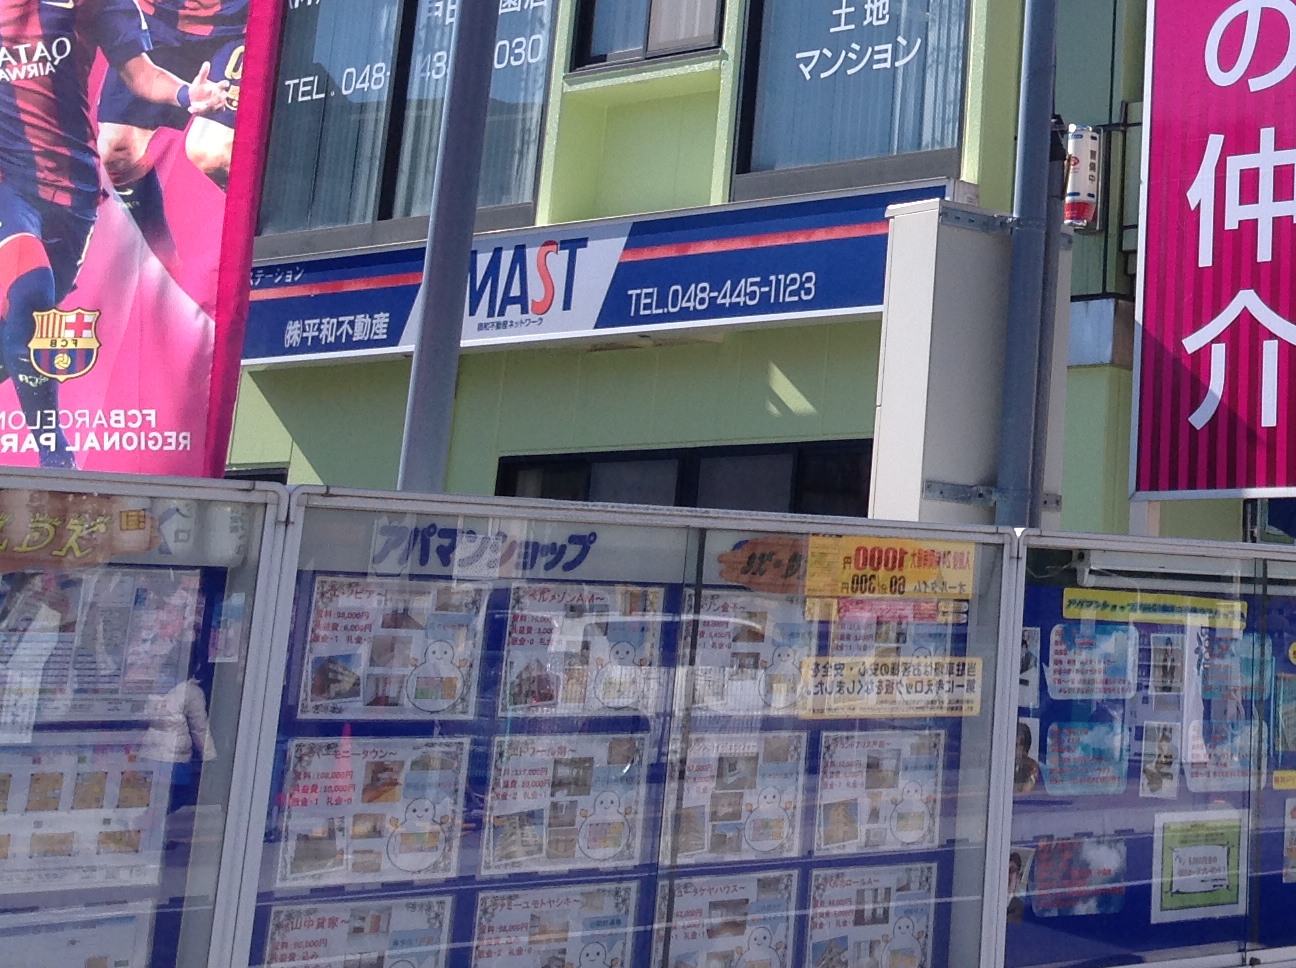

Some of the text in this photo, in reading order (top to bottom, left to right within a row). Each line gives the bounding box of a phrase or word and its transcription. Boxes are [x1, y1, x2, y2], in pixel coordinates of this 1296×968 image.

[795, 35, 921, 81] マンション
[627, 270, 816, 318] TEL.048-445-1123
